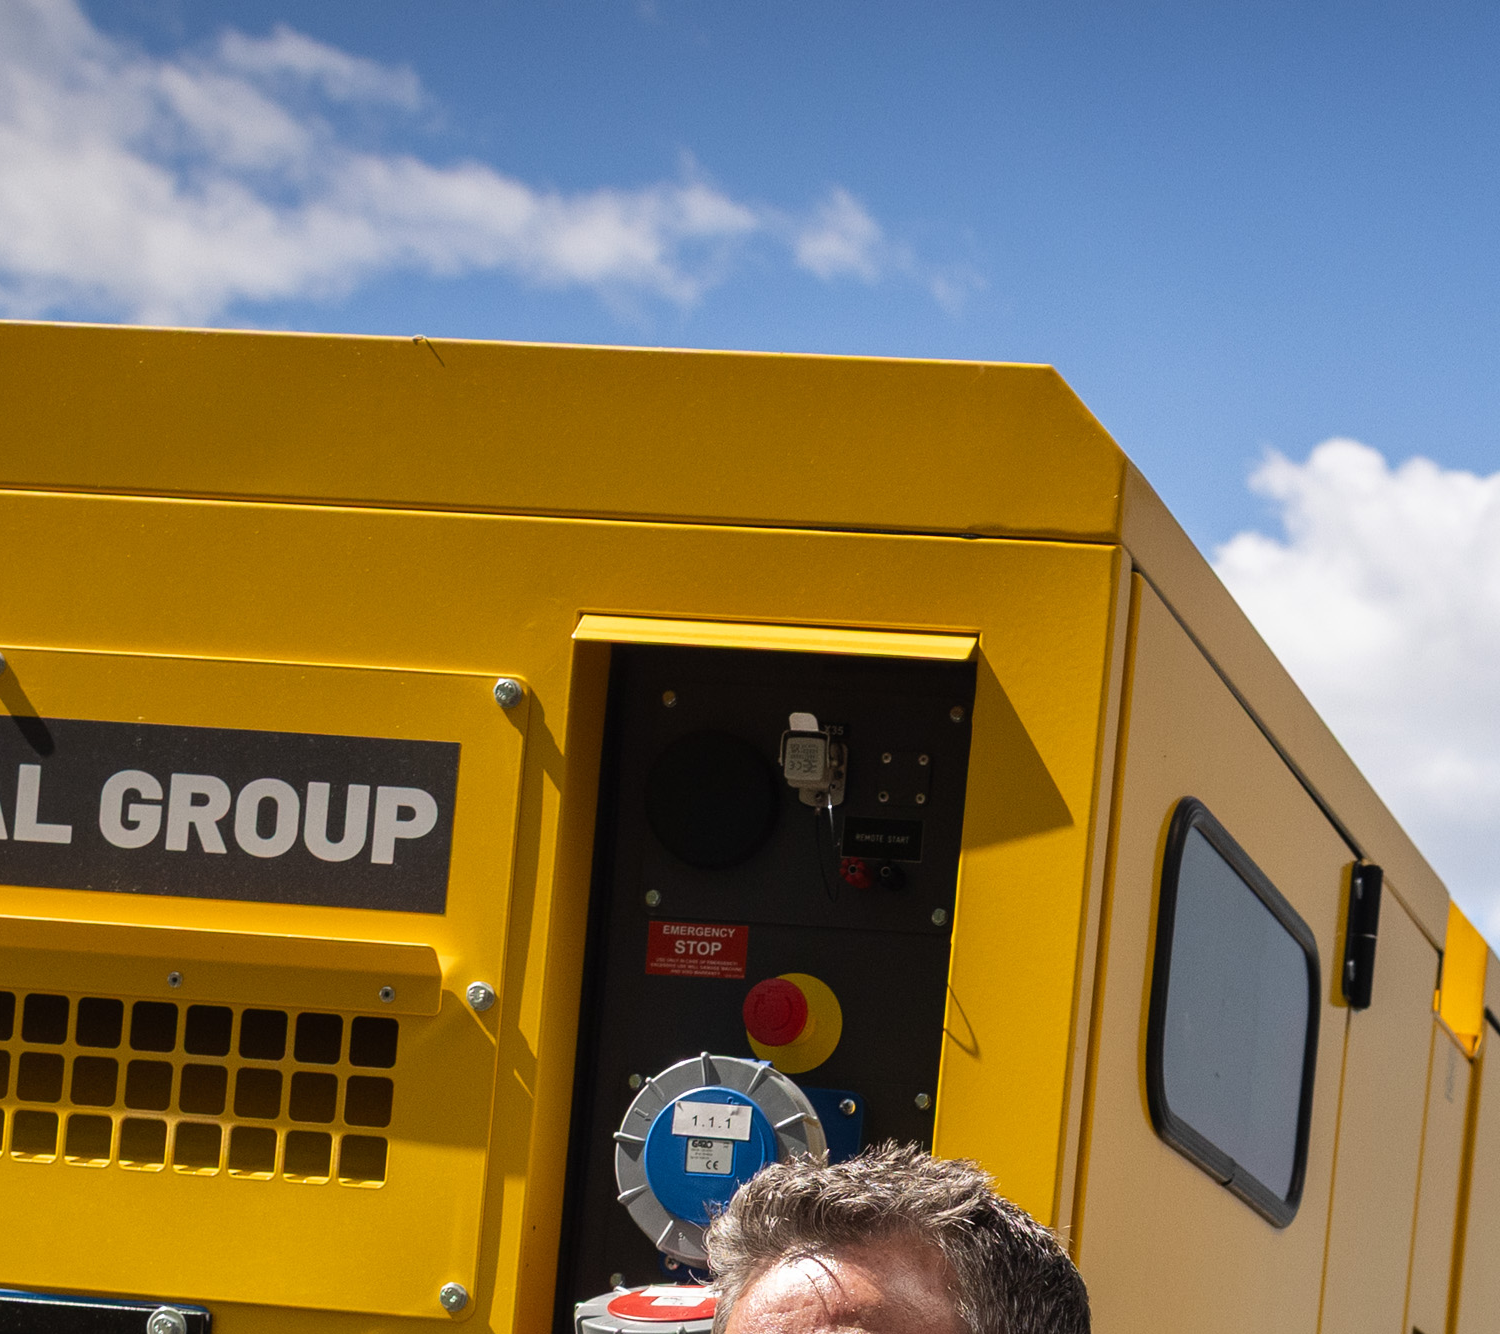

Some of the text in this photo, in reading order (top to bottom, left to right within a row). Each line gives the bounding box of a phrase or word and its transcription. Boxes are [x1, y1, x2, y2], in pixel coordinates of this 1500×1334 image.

[99, 768, 439, 866] GROUP
[855, 833, 910, 844] REMOTE START
[663, 925, 736, 938] EMERGENCY
[674, 940, 722, 956] STOP
[692, 1114, 731, 1129] 1.1.1
